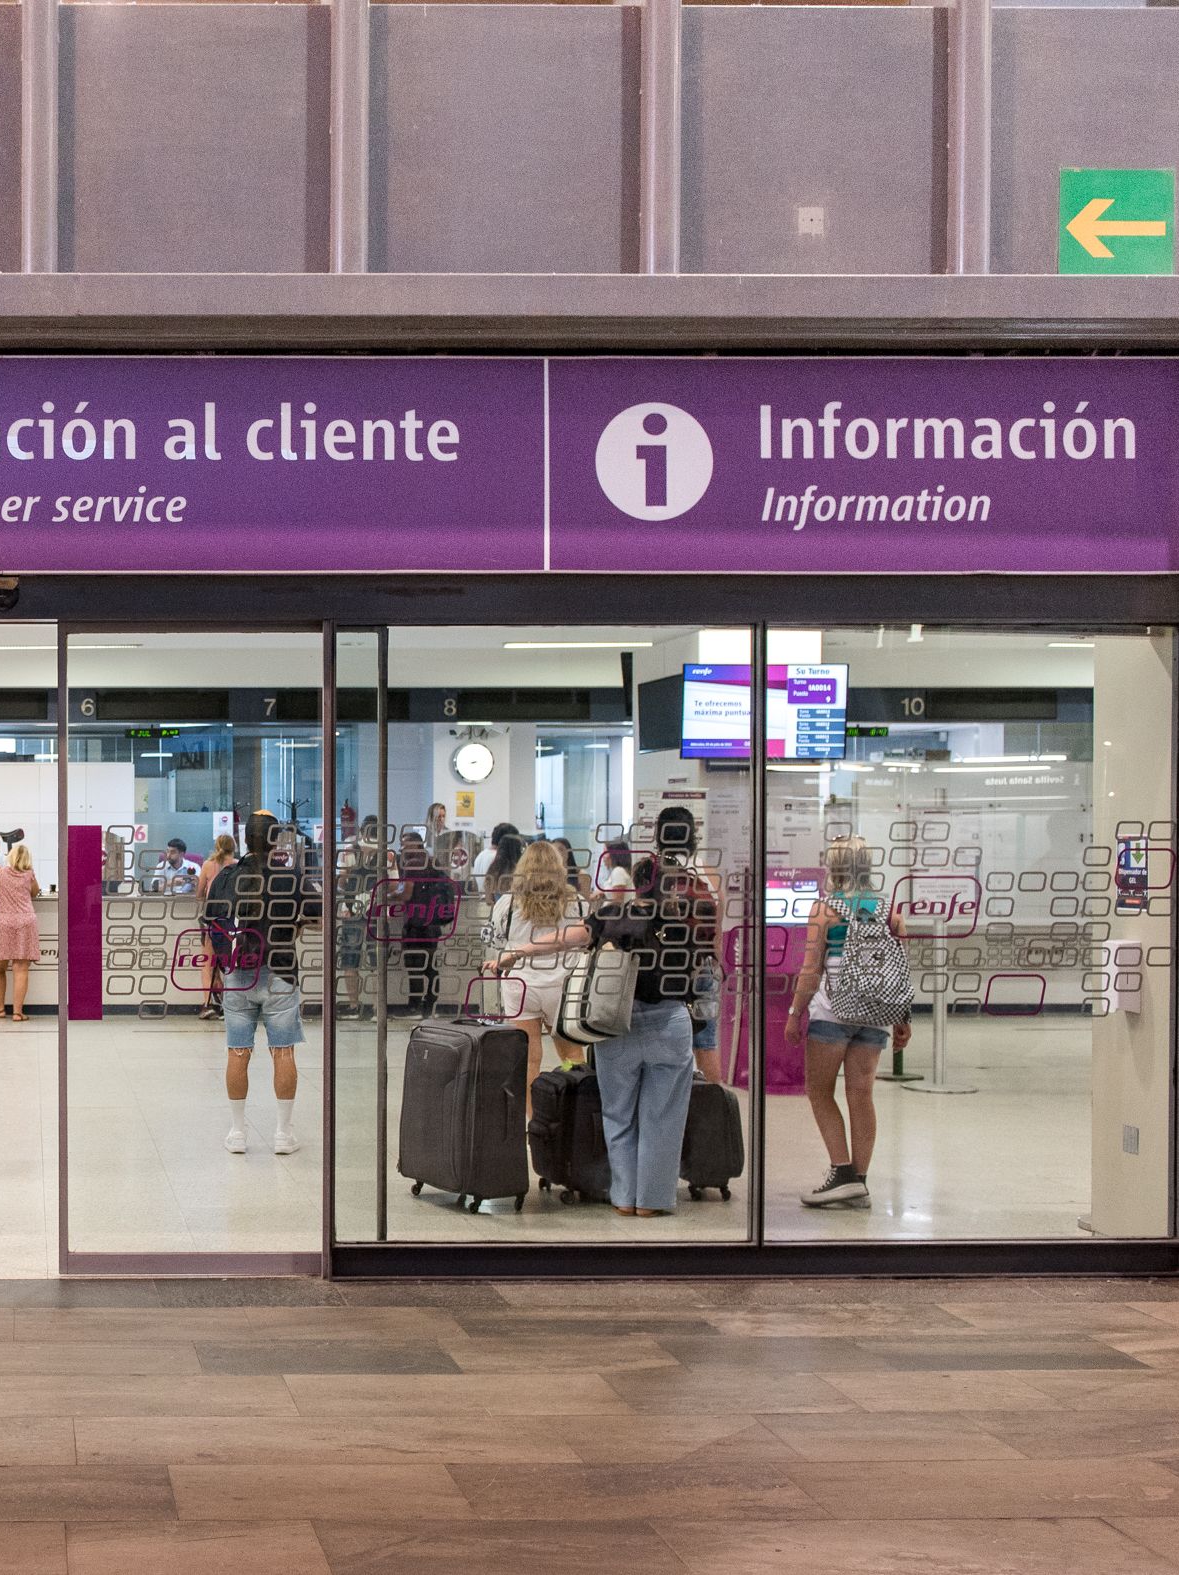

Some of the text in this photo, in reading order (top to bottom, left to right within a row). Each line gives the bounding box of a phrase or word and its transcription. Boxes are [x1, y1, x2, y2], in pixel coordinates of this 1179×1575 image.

[164, 402, 221, 461] al
[247, 402, 460, 461] cliente
[760, 402, 1136, 460] Información
[52, 486, 187, 522] service
[762, 486, 991, 531] Information
[692, 667, 713, 676] renfe
[80, 698, 95, 716] 6
[263, 698, 277, 716] 7
[443, 698, 457, 717] 8
[901, 697, 925, 716] 10
[134, 825, 146, 841] 6
[375, 894, 456, 927] renfe
[896, 891, 976, 923] renfe
[177, 944, 259, 976] renfe
